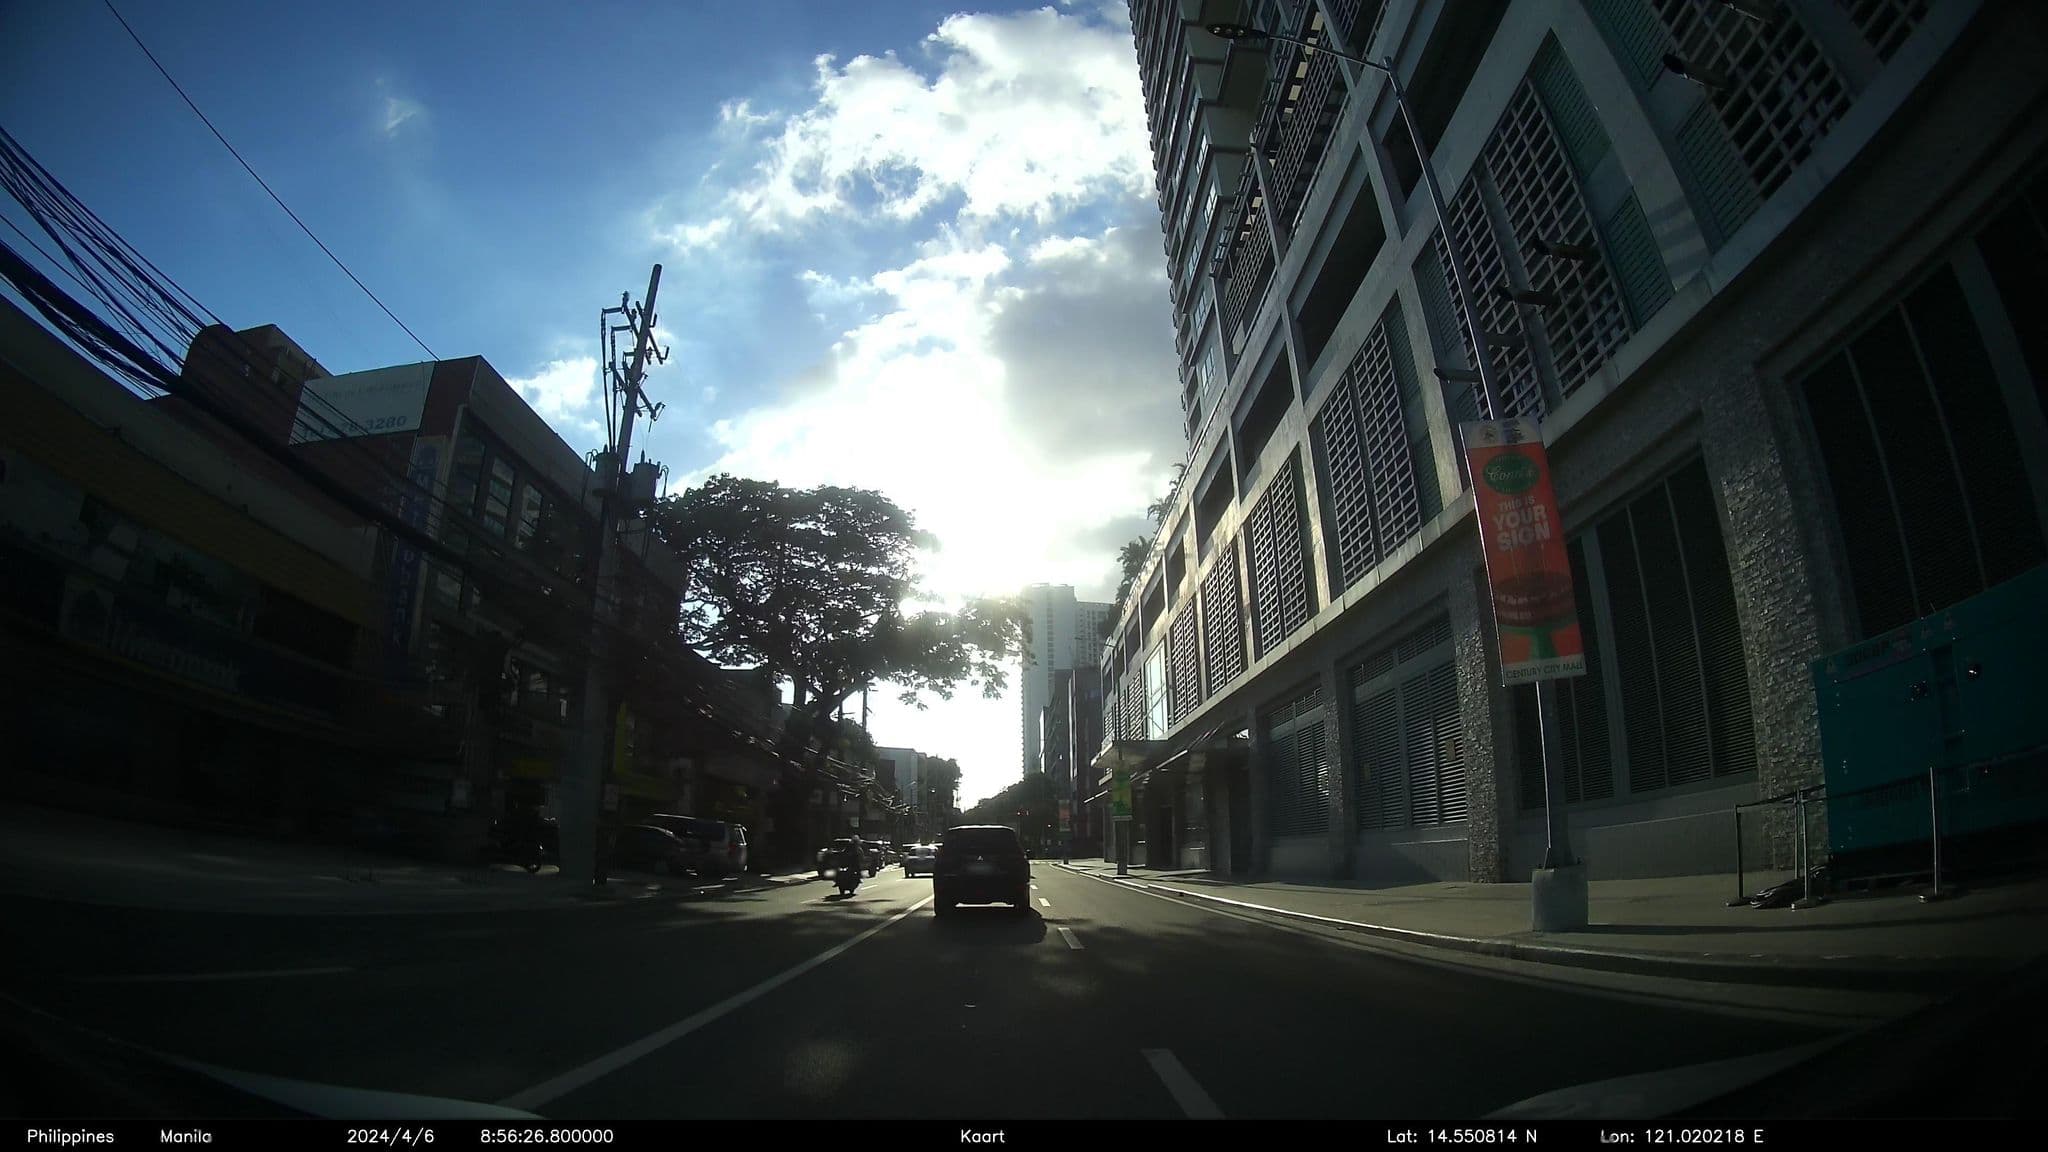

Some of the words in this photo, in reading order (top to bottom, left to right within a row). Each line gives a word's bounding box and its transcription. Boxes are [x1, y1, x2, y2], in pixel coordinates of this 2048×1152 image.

[365, 414, 408, 431] 3280
[1497, 498, 1523, 512] THIS
[1526, 495, 1536, 506] IS
[1492, 503, 1549, 531] YOUR
[1496, 523, 1551, 552] SIGN
[1505, 665, 1543, 679] CENTURY
[1543, 663, 1561, 674] CITY
[1562, 660, 1584, 671] MALL
